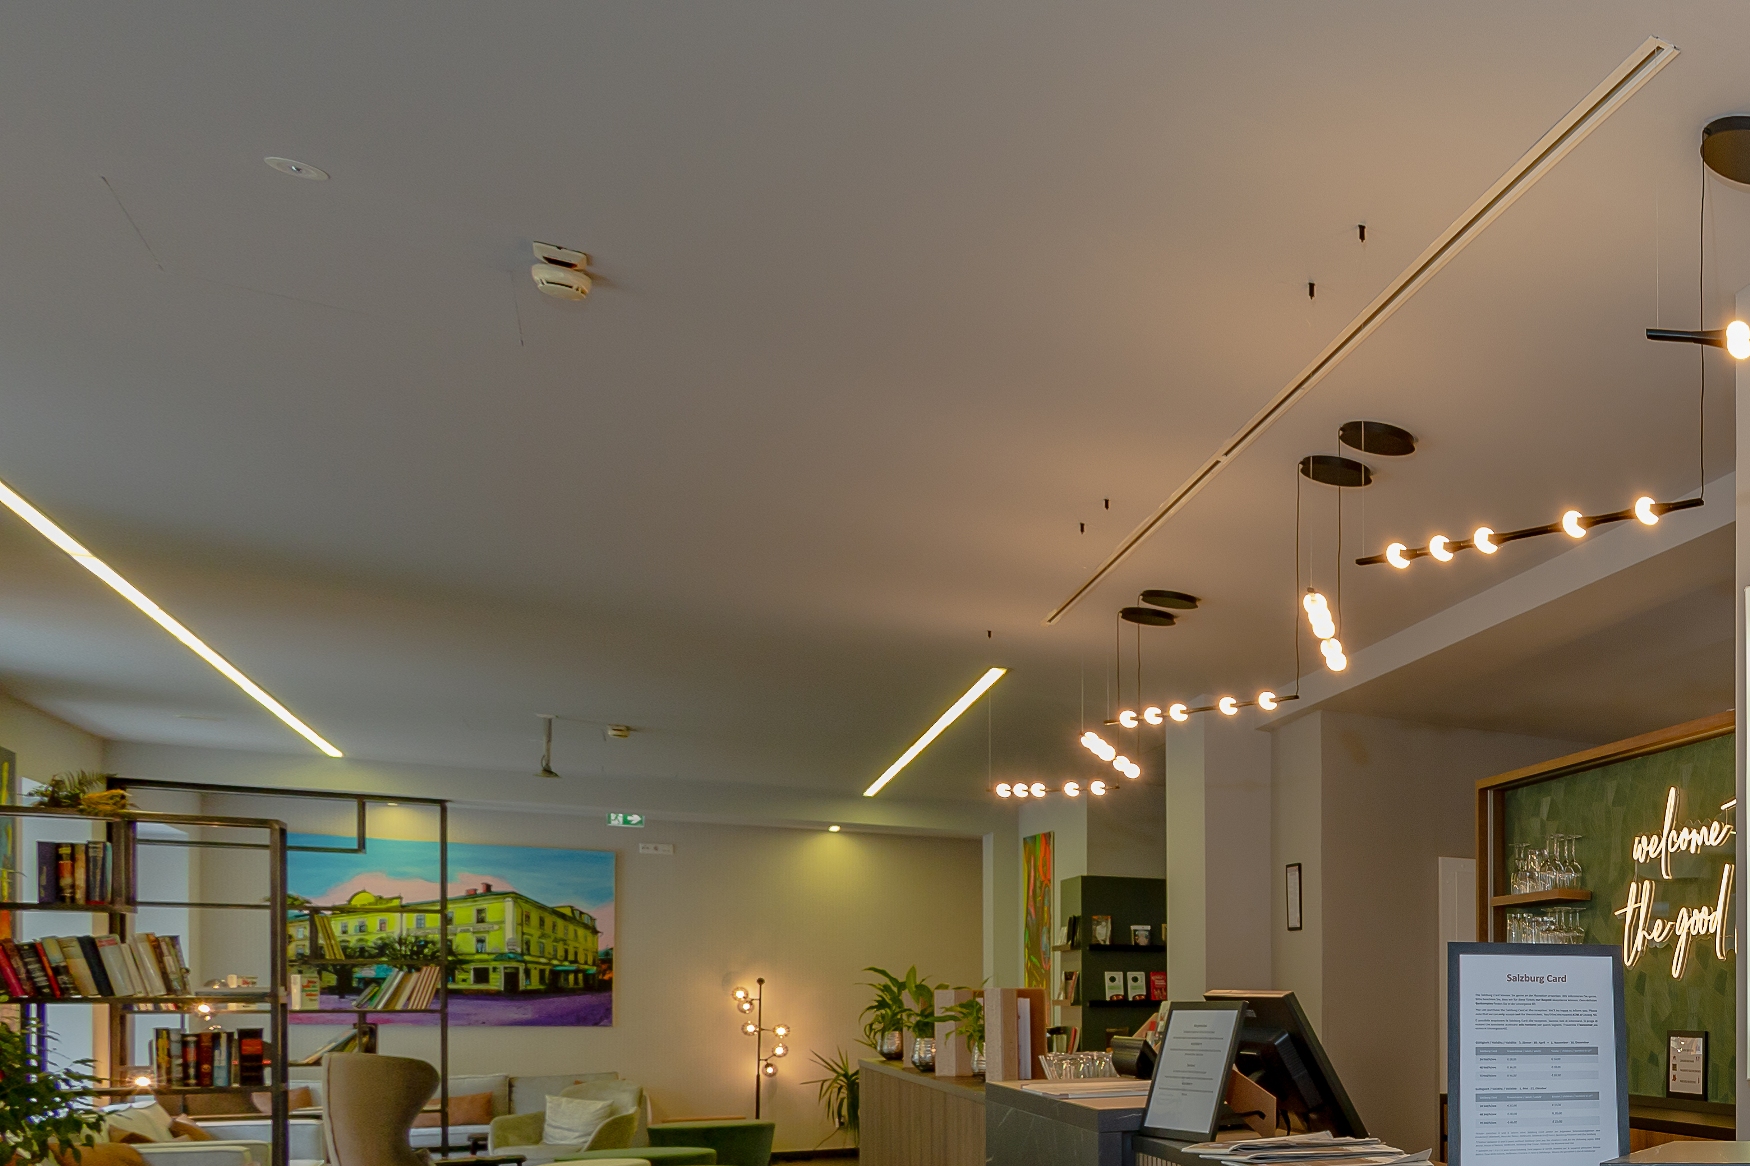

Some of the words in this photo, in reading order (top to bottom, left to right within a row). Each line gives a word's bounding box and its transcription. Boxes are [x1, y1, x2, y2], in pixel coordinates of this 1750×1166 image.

[1632, 786, 1734, 880] welcome
[1614, 880, 1675, 969] the
[1672, 863, 1735, 981] good
[1506, 973, 1544, 984] Salzburg
[1546, 974, 1567, 983] Card
